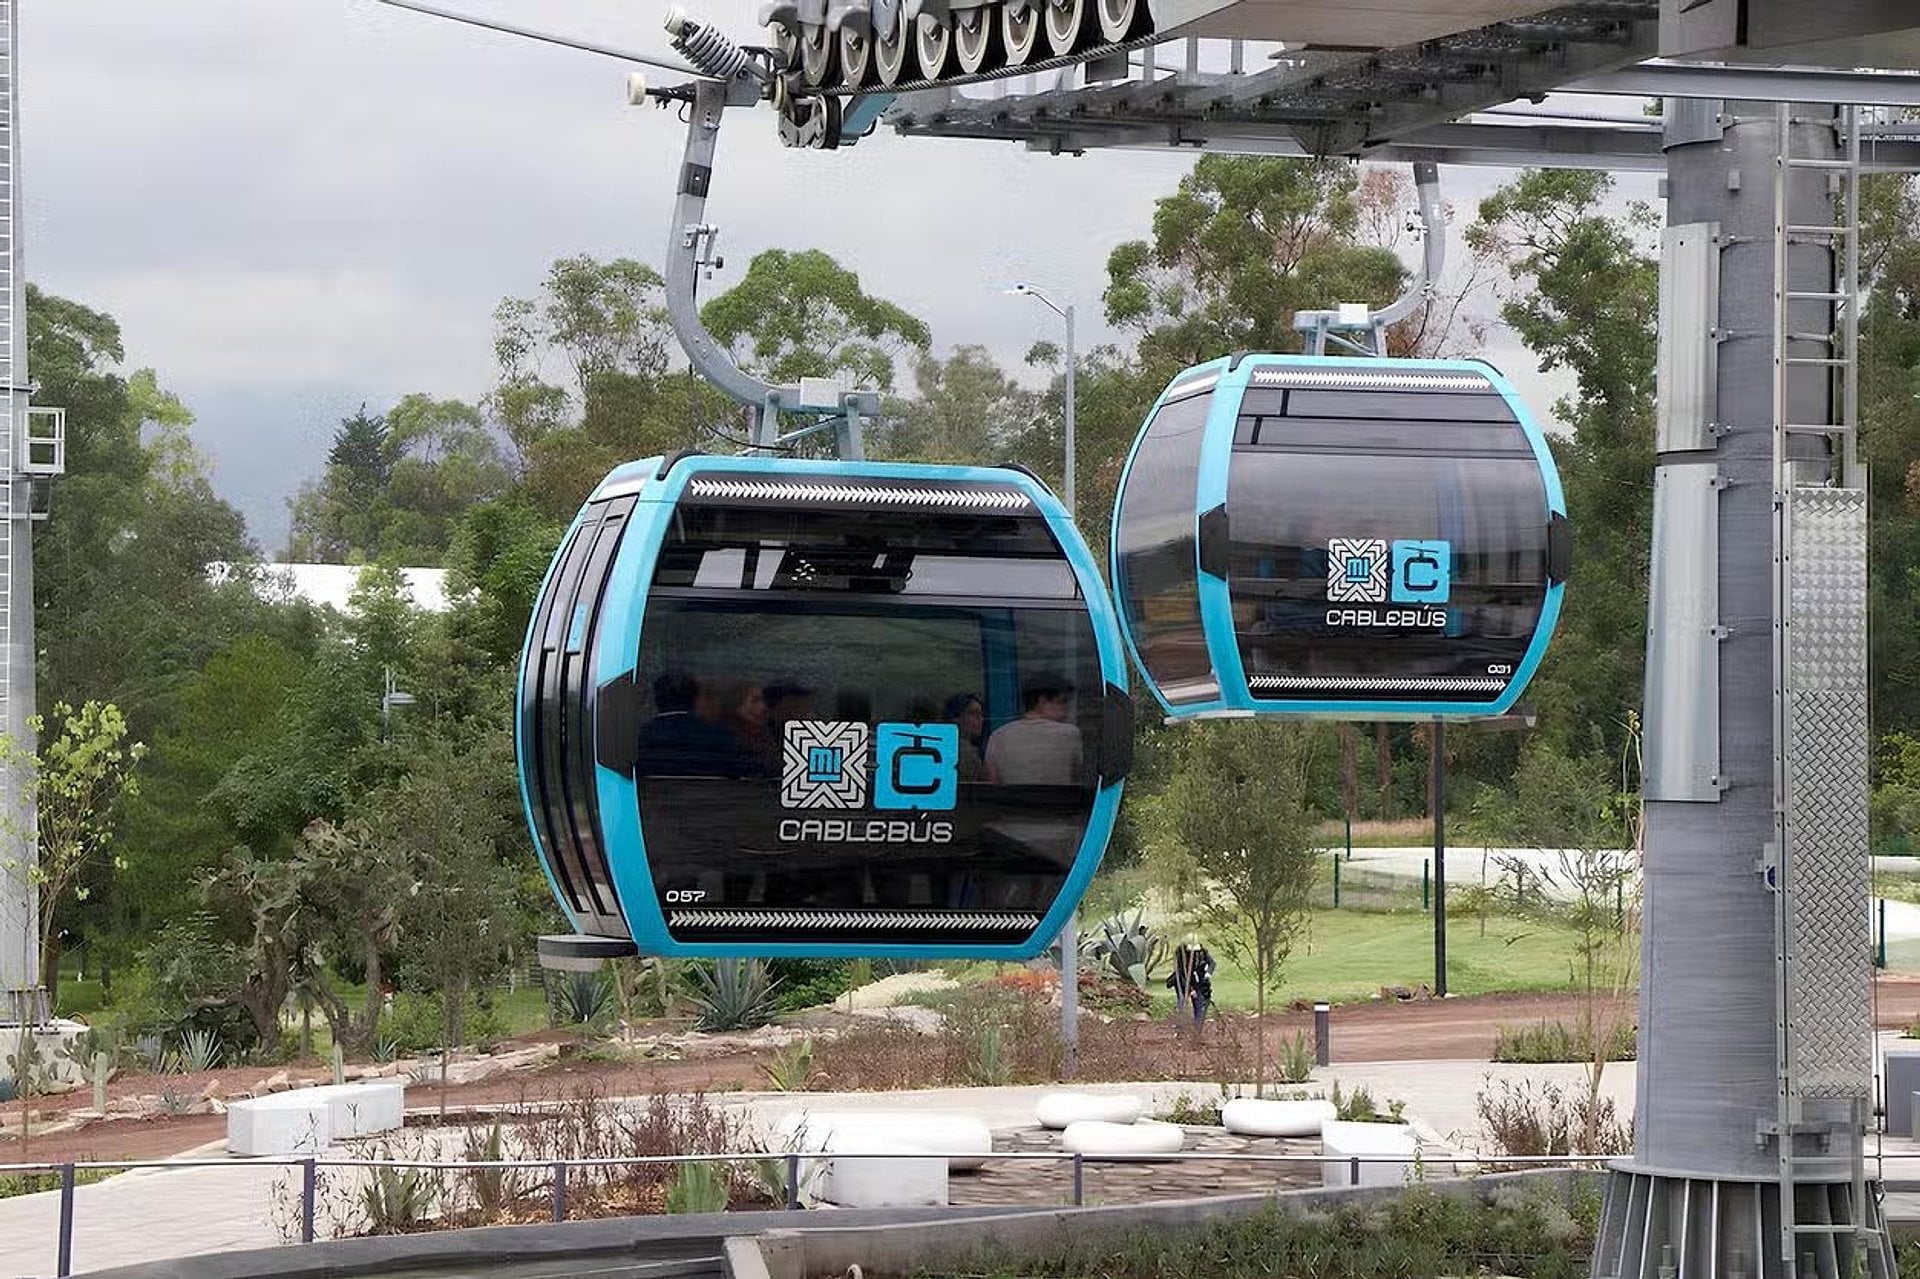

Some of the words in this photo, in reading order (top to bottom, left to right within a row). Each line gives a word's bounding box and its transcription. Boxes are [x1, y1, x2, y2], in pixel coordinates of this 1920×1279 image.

[1326, 605, 1447, 627] CABLEBÚS
[1487, 664, 1511, 674] 031
[779, 813, 953, 843] CABLEBÚS
[666, 890, 706, 902] 057
